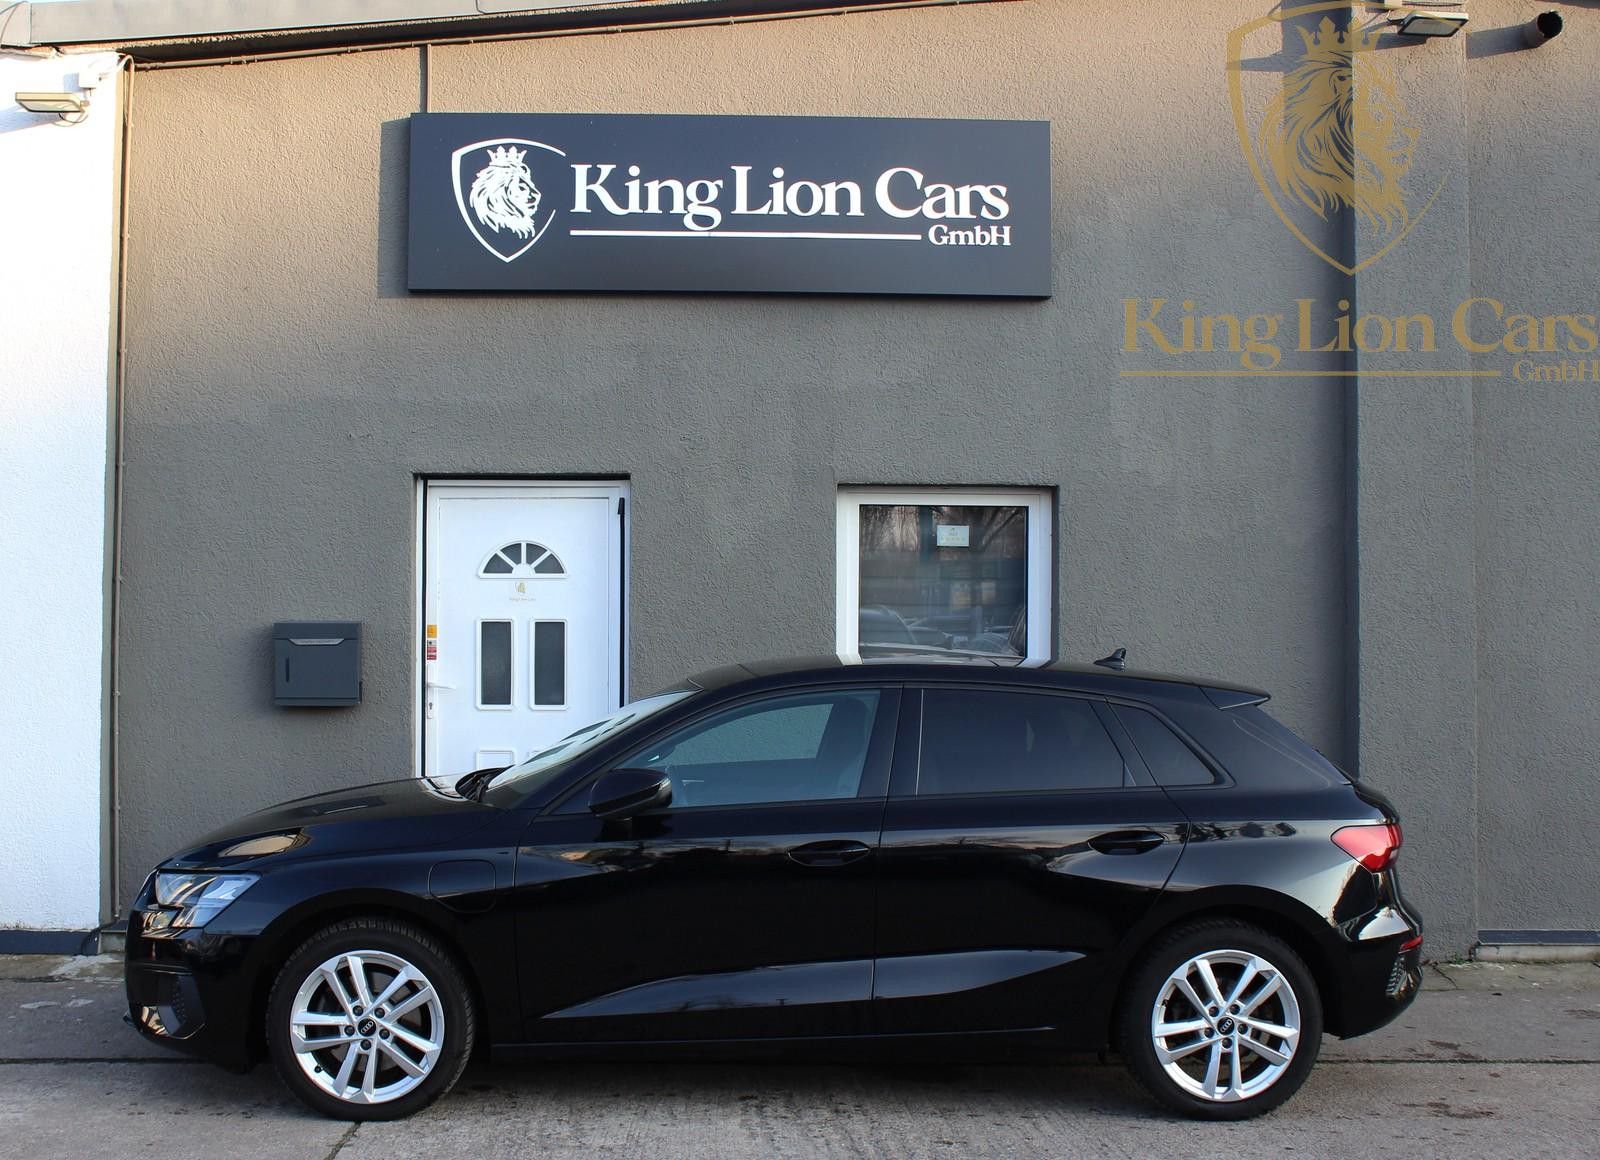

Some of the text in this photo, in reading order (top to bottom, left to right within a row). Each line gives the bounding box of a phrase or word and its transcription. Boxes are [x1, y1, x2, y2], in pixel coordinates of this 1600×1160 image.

[570, 163, 1010, 232] King Lion Cars
[927, 223, 1012, 247] GmbH
